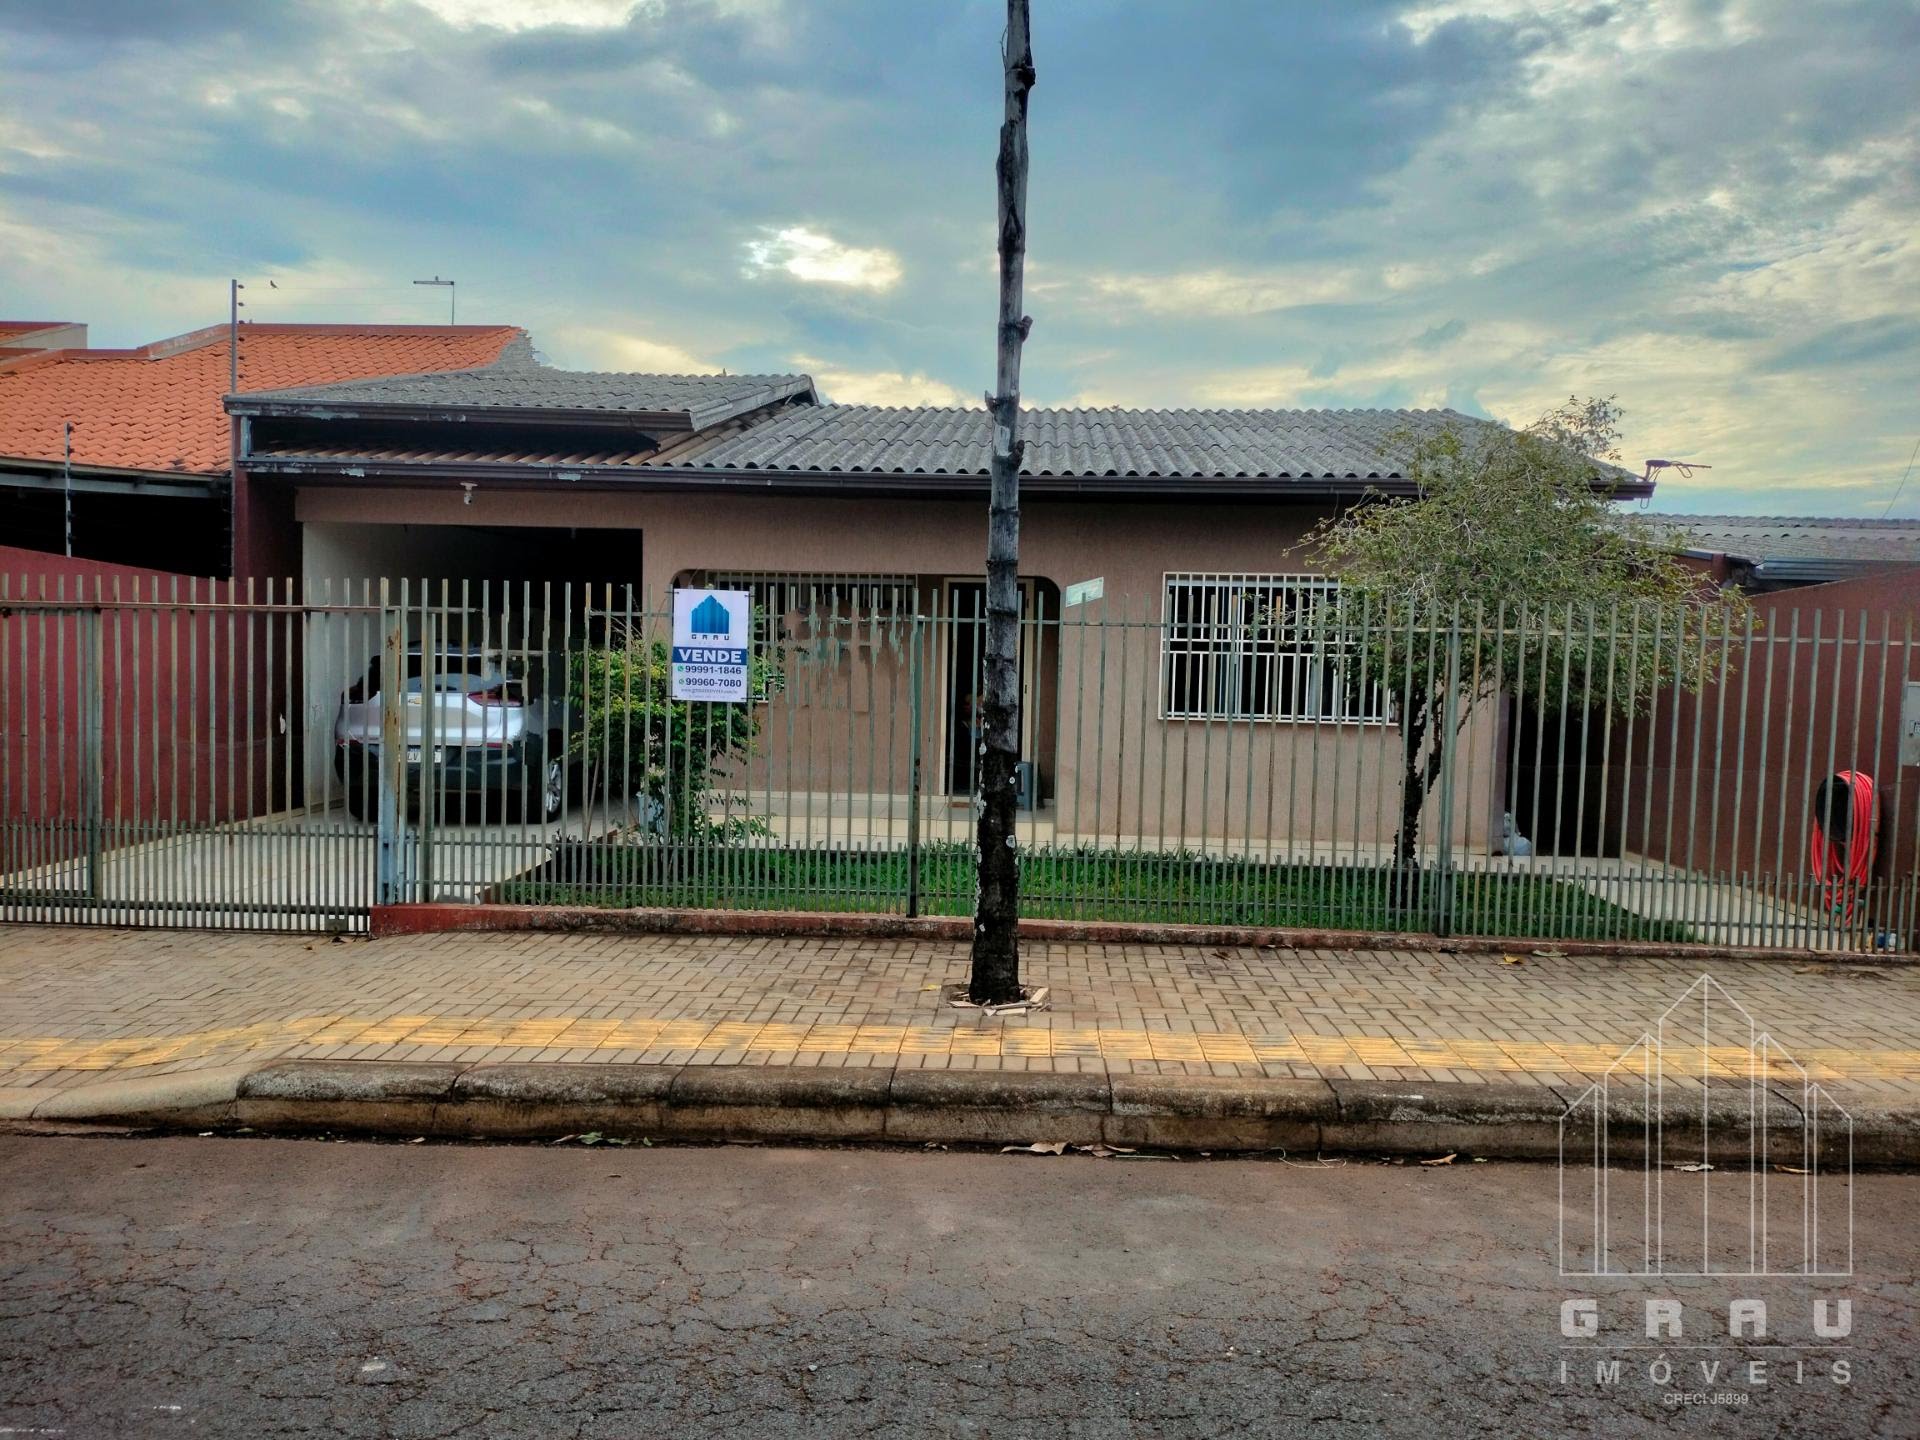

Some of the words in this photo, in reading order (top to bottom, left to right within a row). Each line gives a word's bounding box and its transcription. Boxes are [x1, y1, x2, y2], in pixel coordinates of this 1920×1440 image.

[678, 649, 742, 663] VENDE
[685, 665, 742, 675] 99991-1846
[685, 677, 742, 688] 99960-7080
